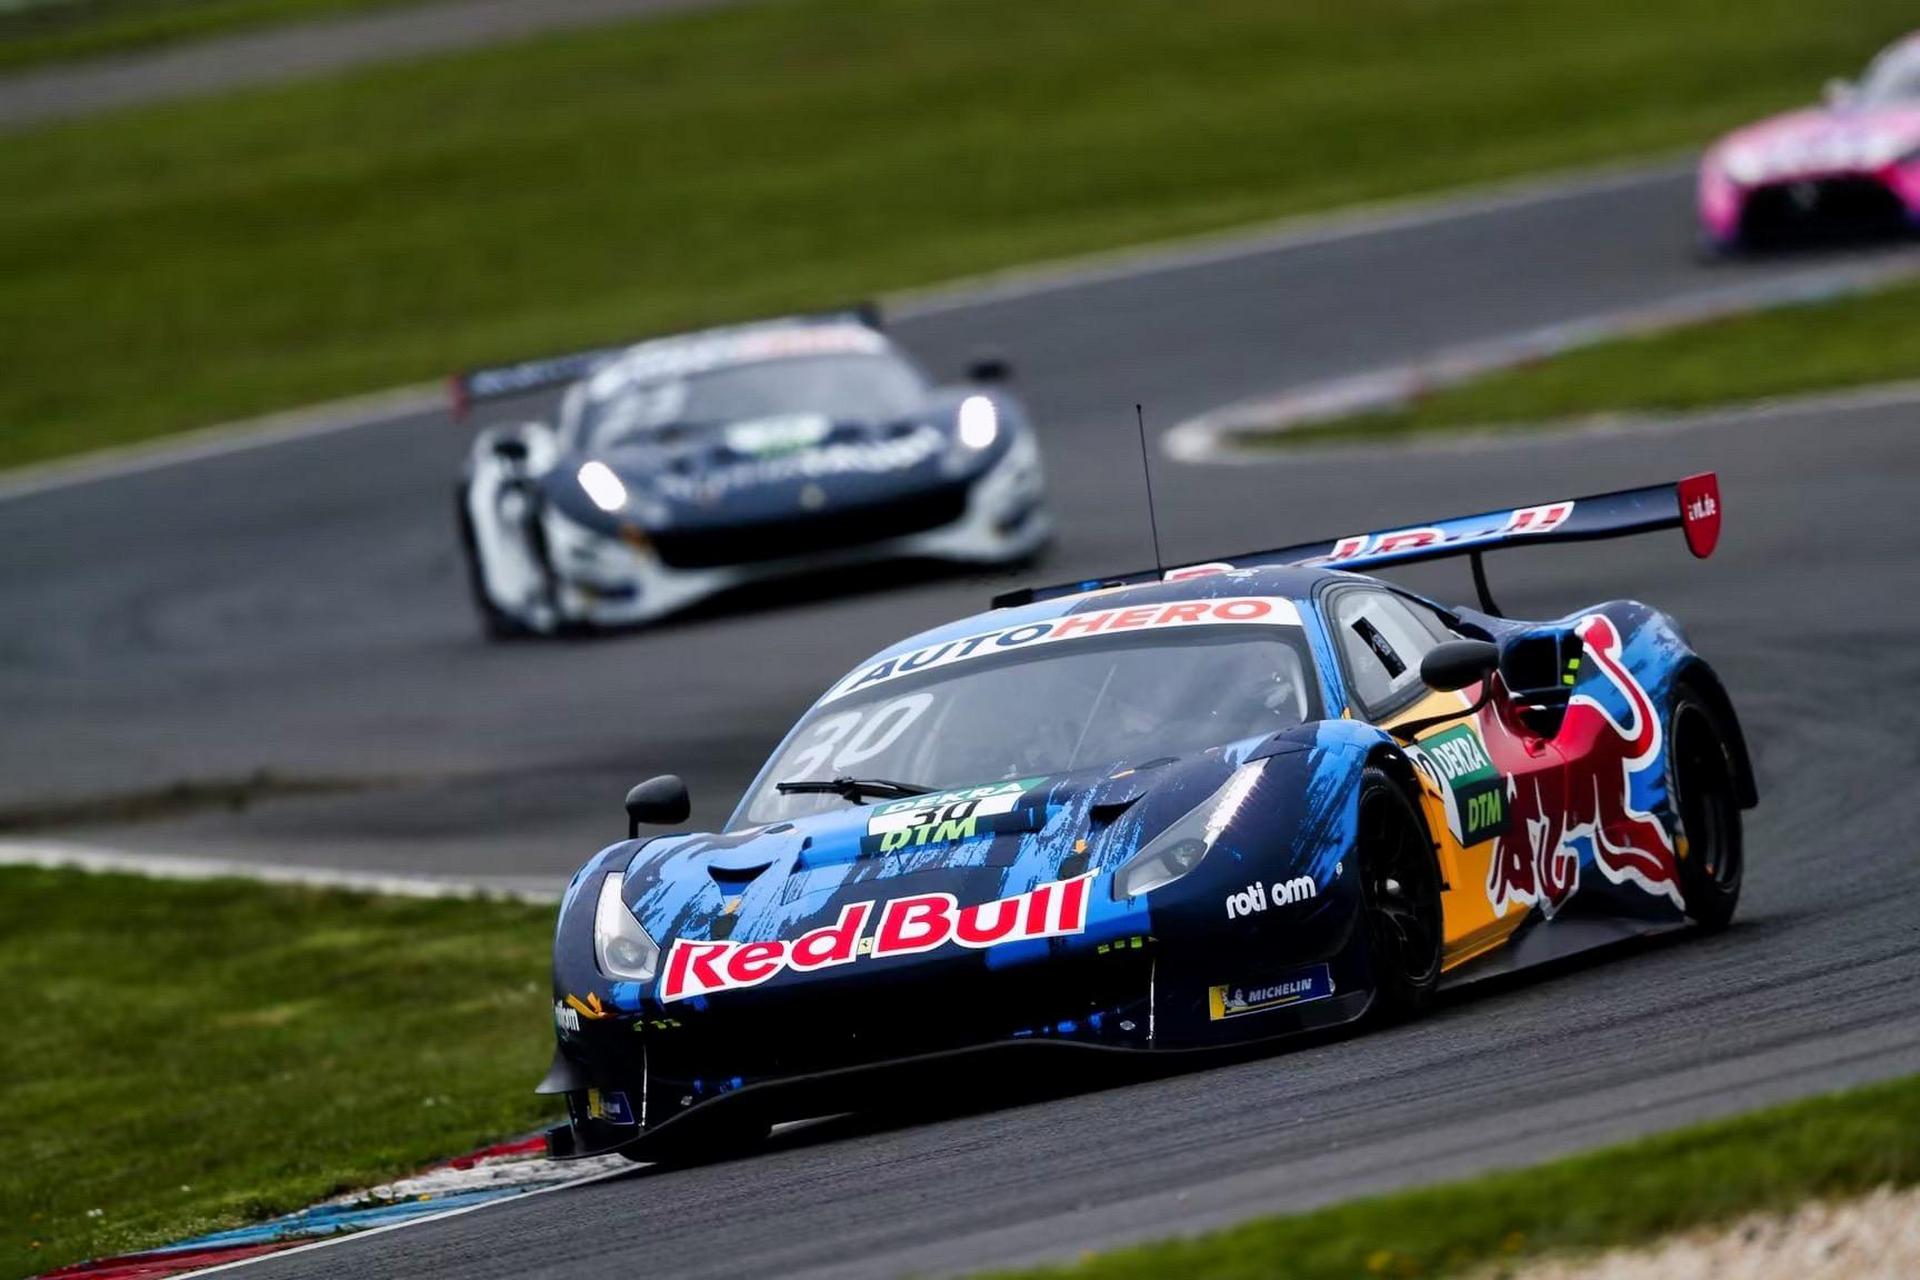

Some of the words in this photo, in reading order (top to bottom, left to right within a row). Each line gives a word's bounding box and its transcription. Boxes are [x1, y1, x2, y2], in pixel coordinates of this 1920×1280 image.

[851, 600, 1272, 693] AUTOHERO
[778, 693, 934, 783] 30
[1431, 733, 1488, 780] DEKRA
[883, 783, 1022, 814] DEKRA
[906, 799, 983, 828] 30
[1467, 788, 1501, 832] DTM
[880, 816, 977, 852] DTM
[1226, 881, 1267, 919] roti
[1272, 875, 1317, 906] orm
[662, 902, 872, 1001] Red
[873, 877, 1092, 956] Bull
[1248, 978, 1312, 1003] MICHELIN
